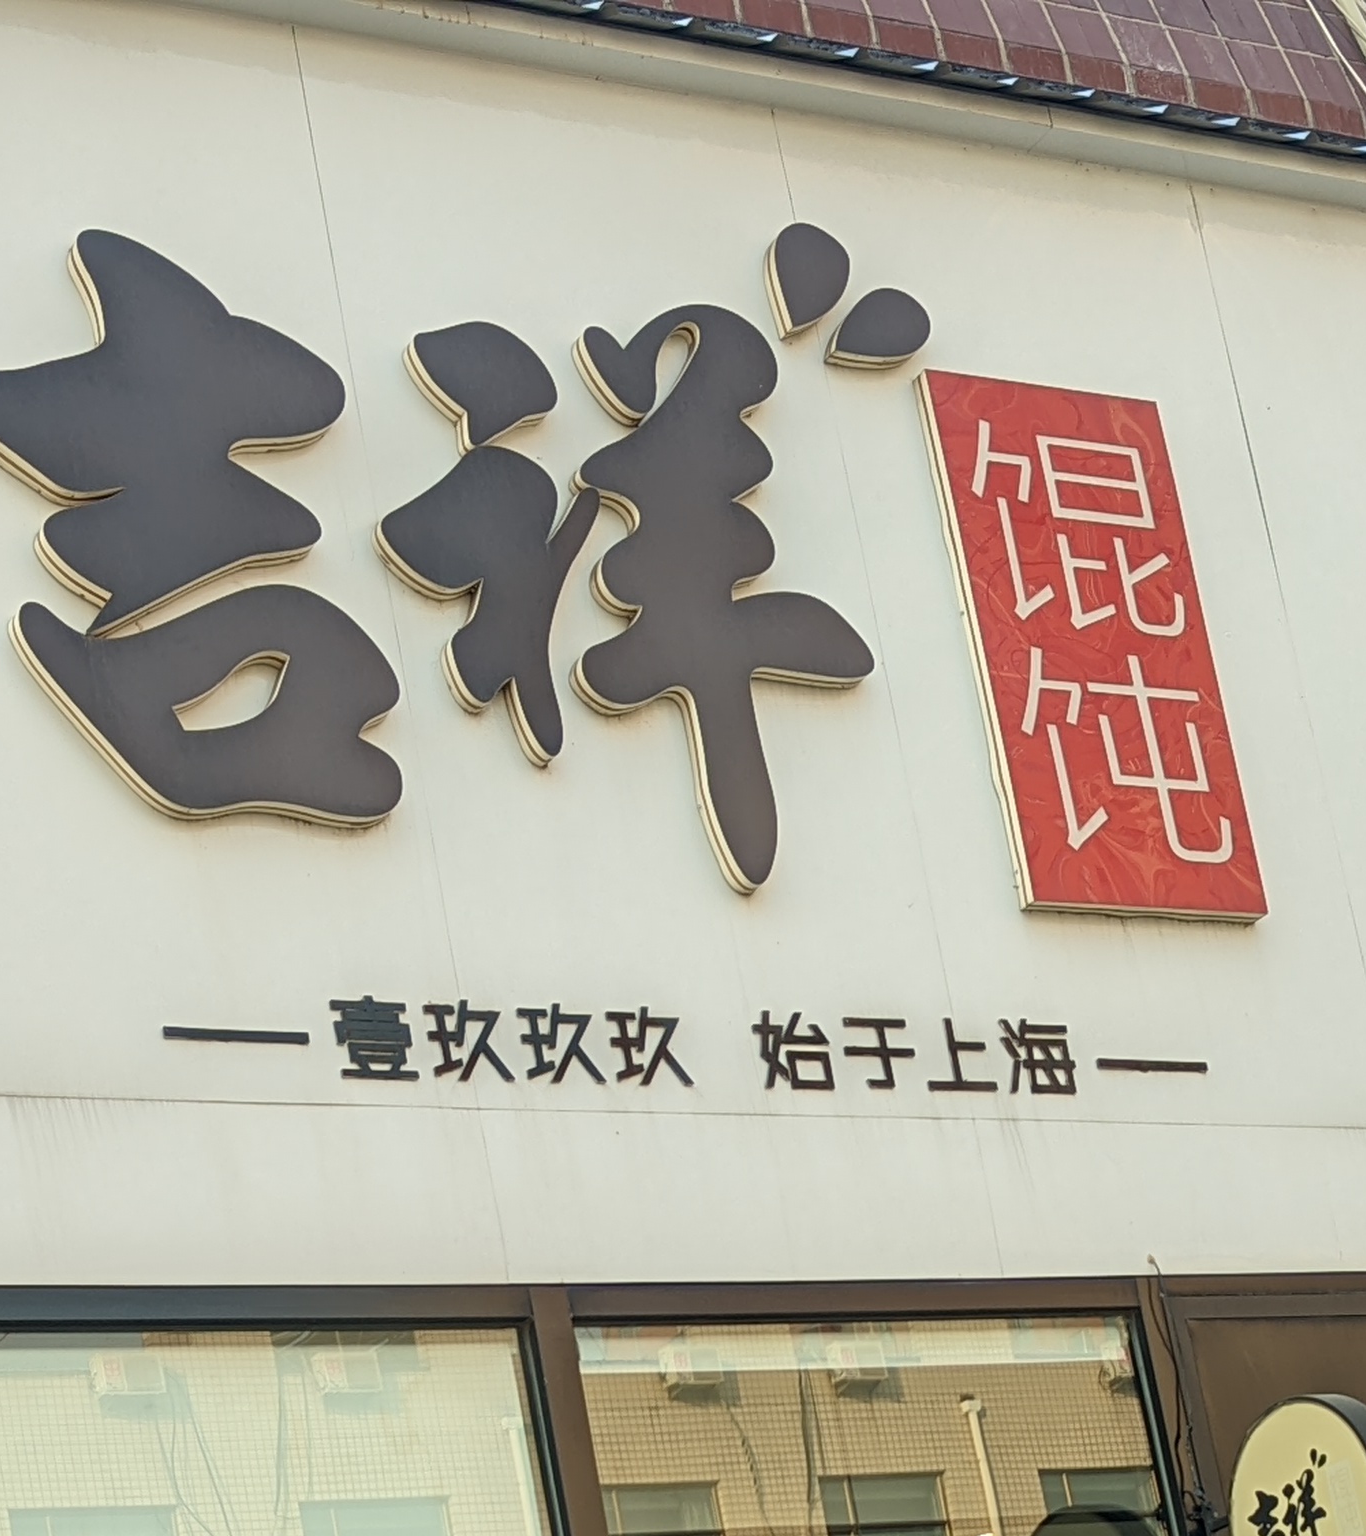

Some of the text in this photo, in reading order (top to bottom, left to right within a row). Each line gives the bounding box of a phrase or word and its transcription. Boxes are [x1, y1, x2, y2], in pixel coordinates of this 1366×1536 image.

[972, 416, 1235, 866] 馄饨
[332, 995, 1079, 1097] 壹玖玖玖 始于上海
